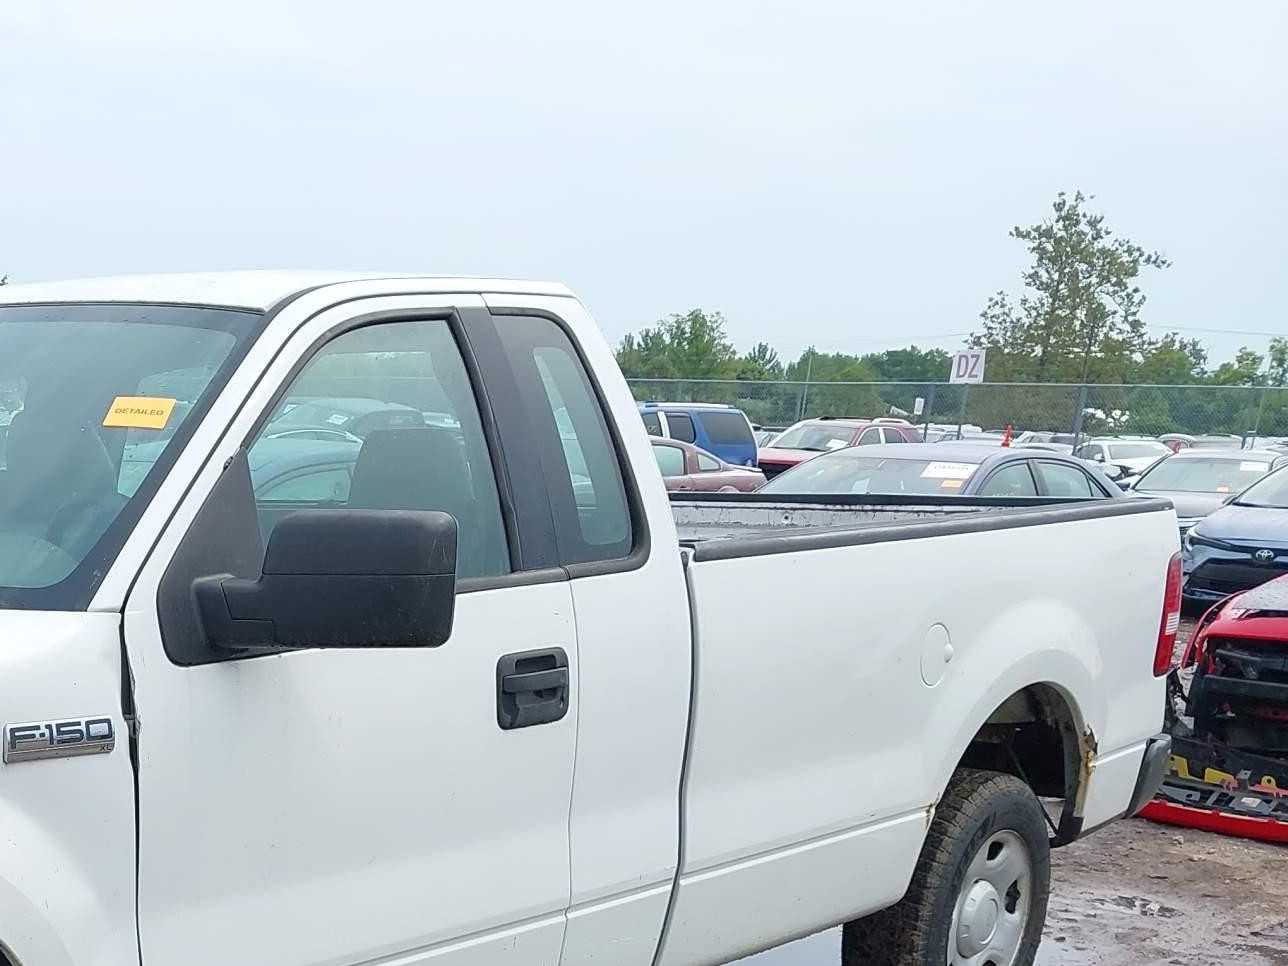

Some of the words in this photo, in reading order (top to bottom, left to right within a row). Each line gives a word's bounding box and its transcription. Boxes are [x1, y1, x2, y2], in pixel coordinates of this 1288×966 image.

[955, 353, 981, 379] DZ
[114, 407, 165, 416] DETAILED
[9, 718, 113, 750] F-150
[100, 744, 112, 752] XL
